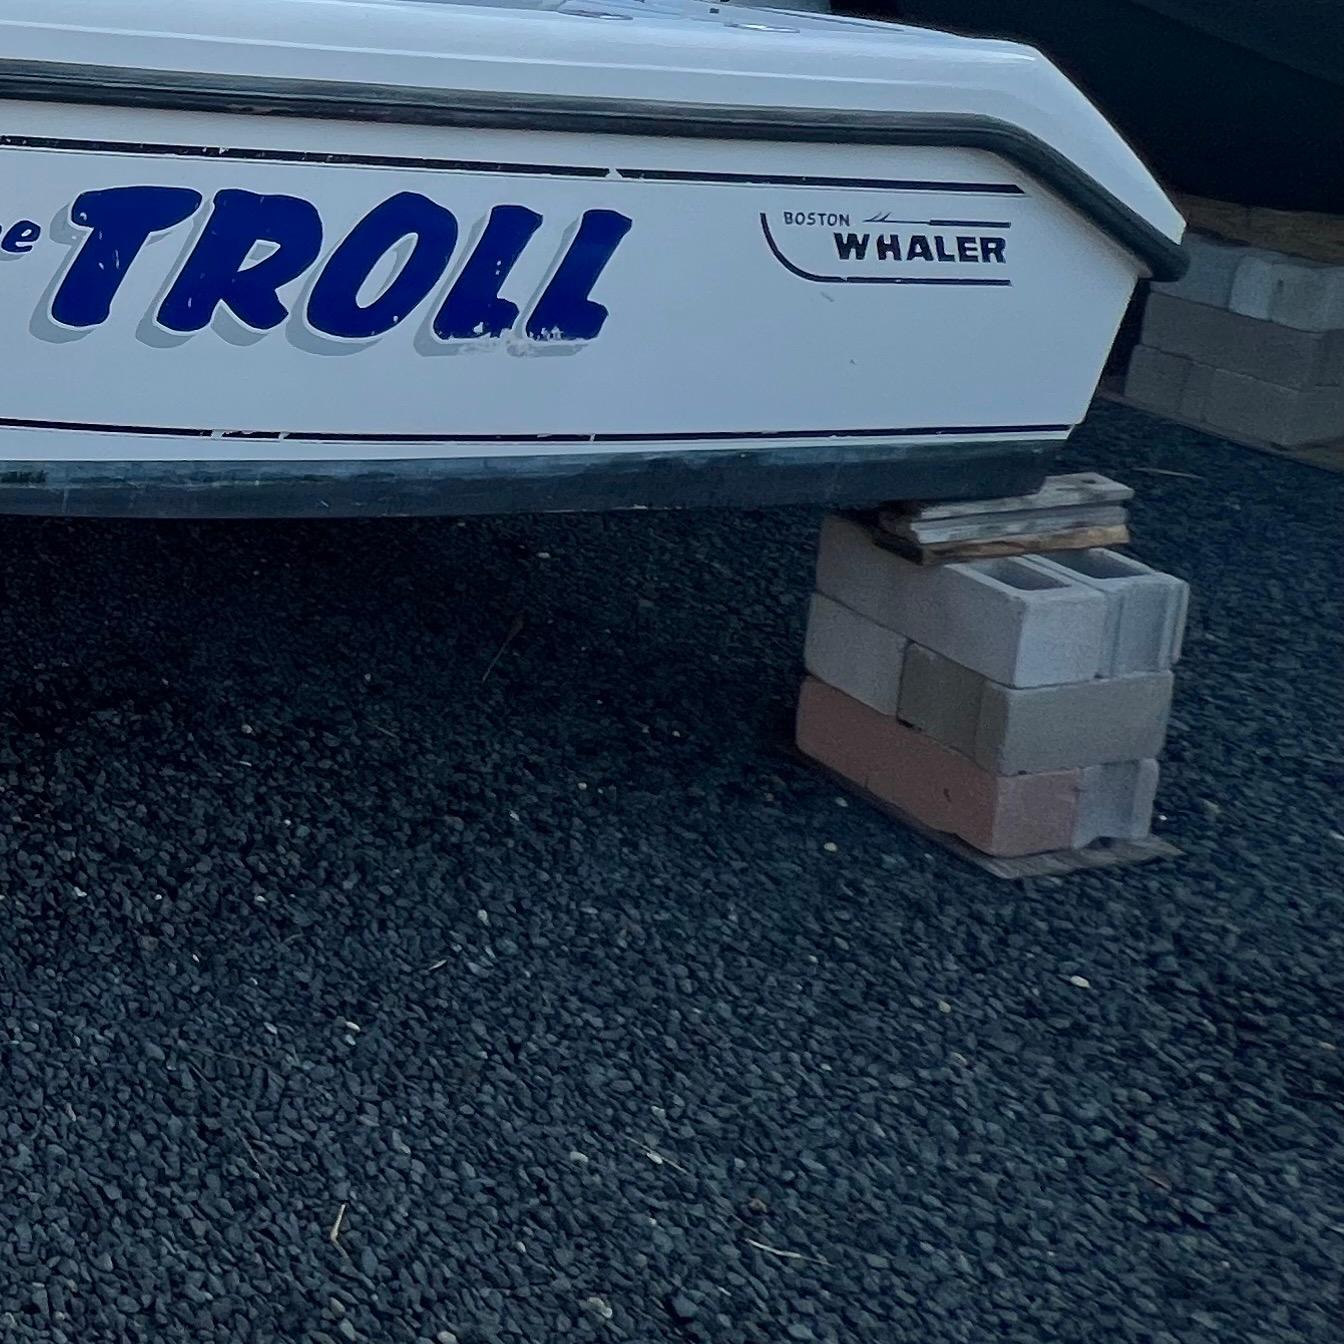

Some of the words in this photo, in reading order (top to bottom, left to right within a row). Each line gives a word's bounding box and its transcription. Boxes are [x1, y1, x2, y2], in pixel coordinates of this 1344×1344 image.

[783, 211, 850, 227] BOSTON
[833, 232, 1007, 264] WHALER
[45, 185, 633, 344] TROLL
